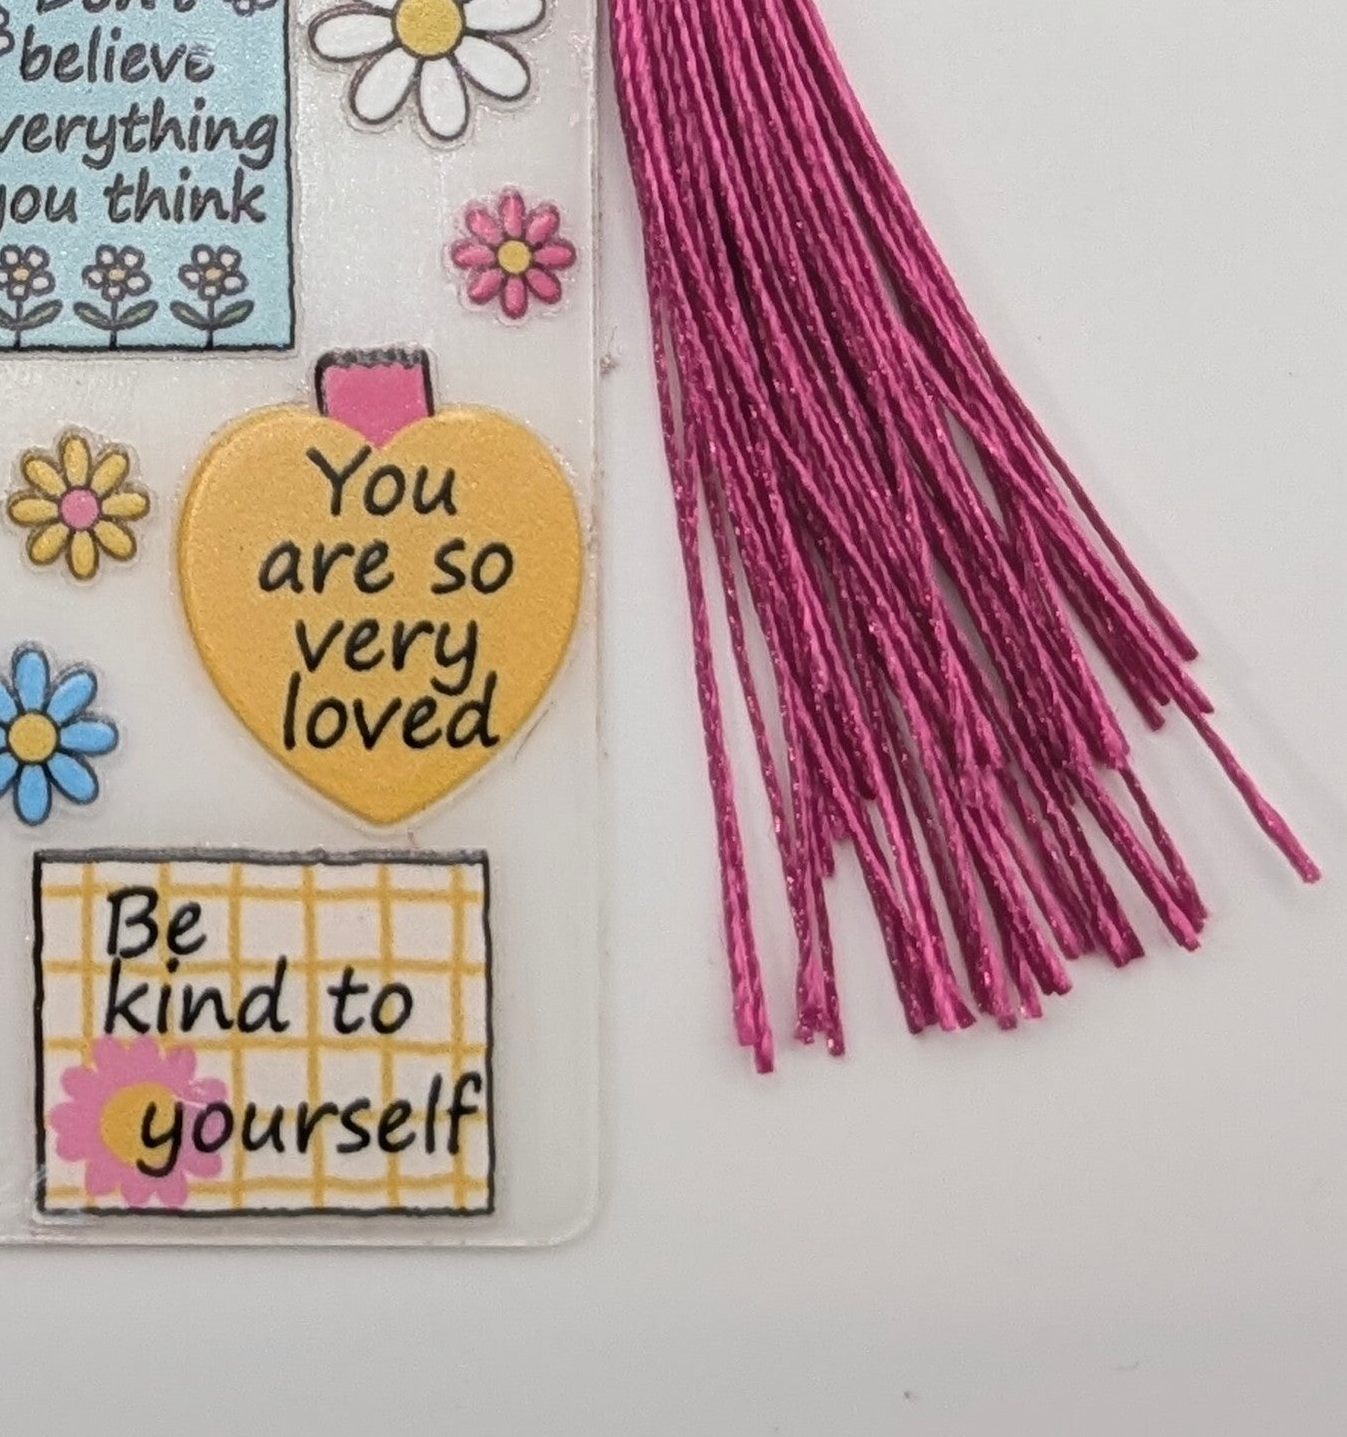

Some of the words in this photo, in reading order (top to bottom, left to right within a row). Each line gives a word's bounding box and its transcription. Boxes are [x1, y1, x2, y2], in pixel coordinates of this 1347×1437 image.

[19, 27, 215, 84] believe
[105, 167, 267, 225] think
[306, 446, 455, 517] You
[258, 541, 395, 595] are
[432, 539, 514, 596] so
[294, 618, 478, 697] very
[282, 672, 500, 753] loved
[105, 887, 207, 956] Be
[102, 954, 291, 1037] kind
[330, 966, 412, 1035] to
[136, 1073, 482, 1178] yourself
